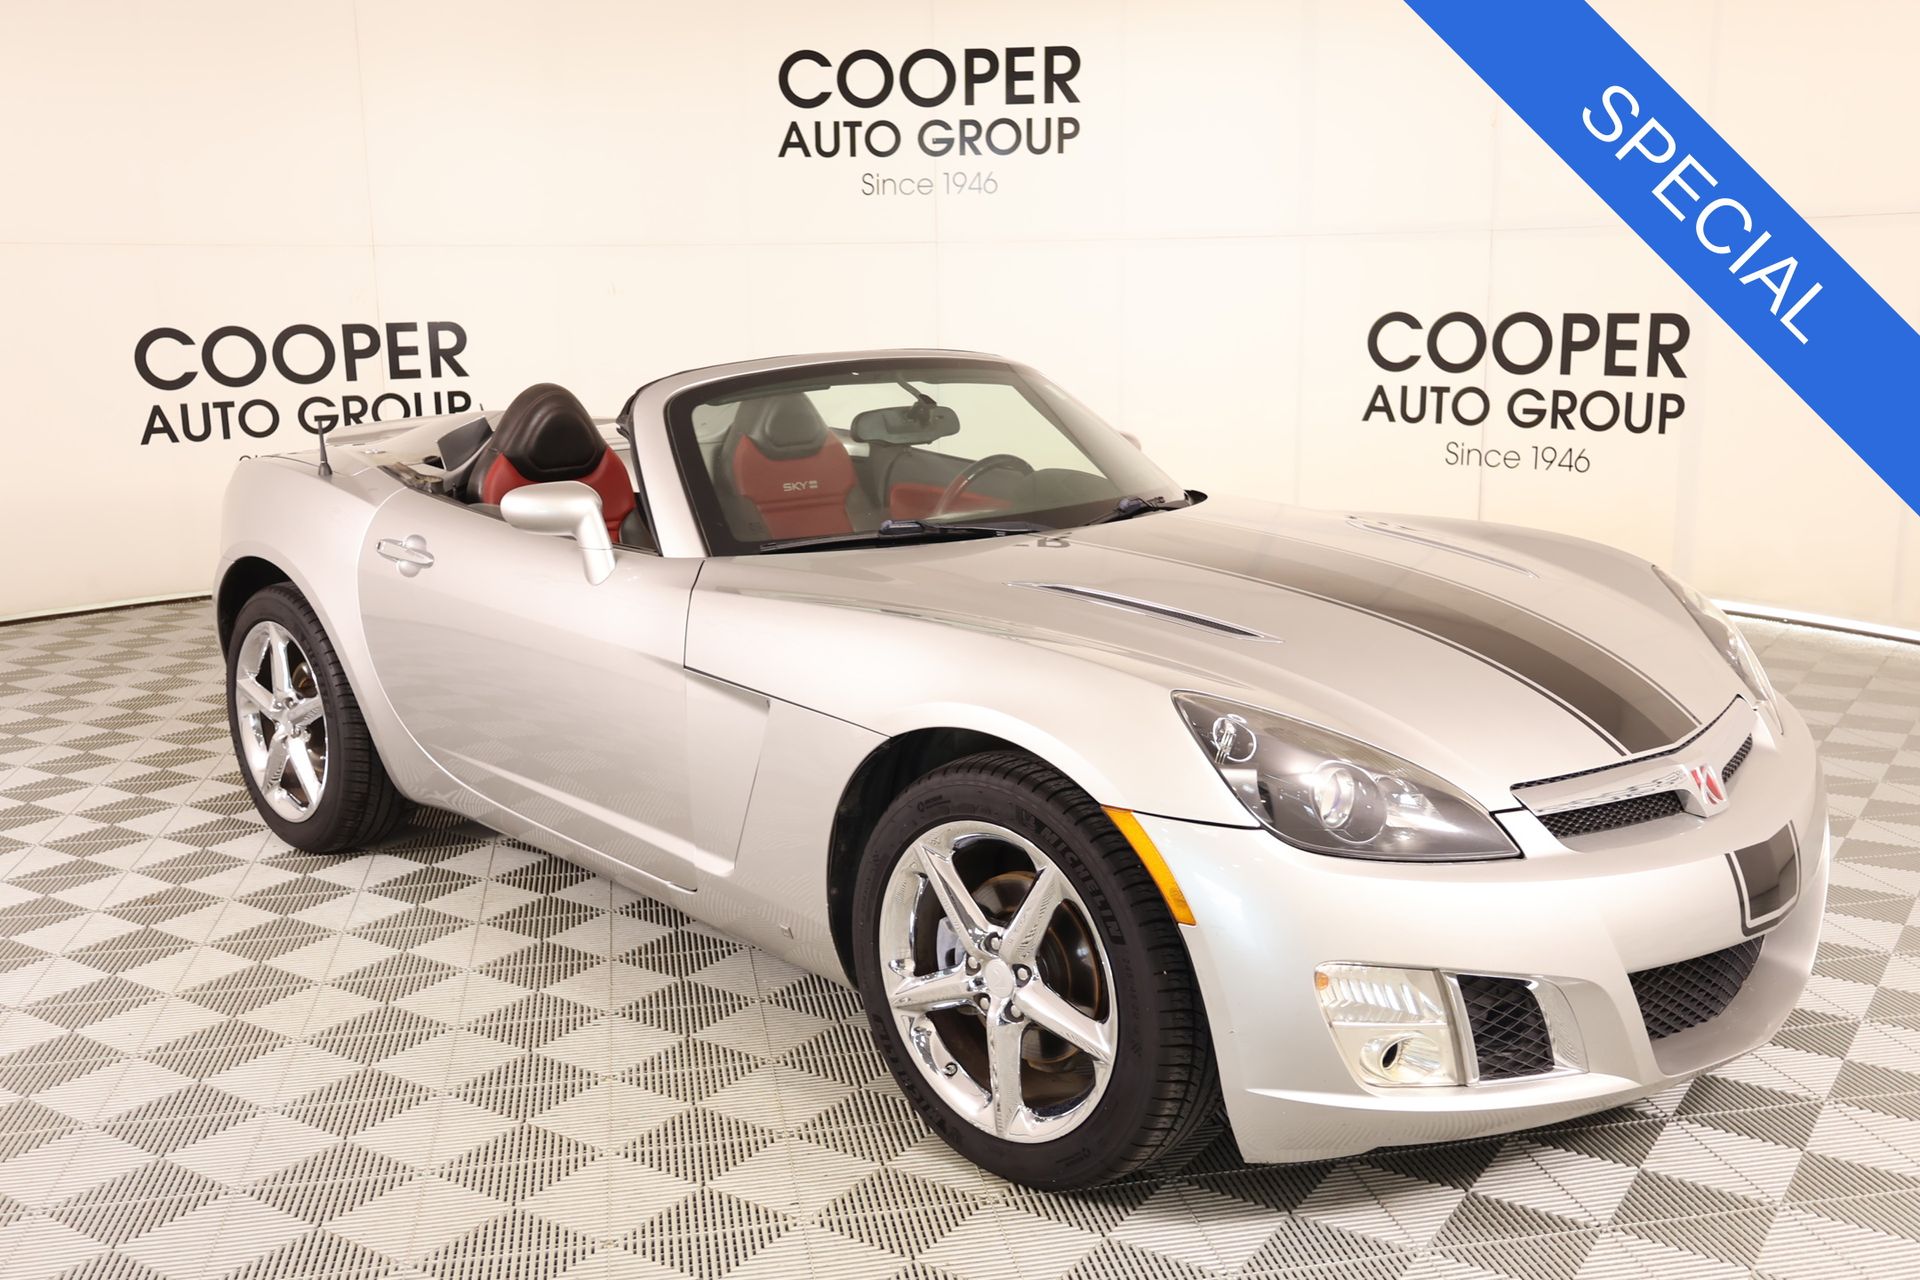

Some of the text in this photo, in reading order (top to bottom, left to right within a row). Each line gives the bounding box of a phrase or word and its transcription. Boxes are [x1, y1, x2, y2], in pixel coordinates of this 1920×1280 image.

[778, 45, 1081, 109] COOPER
[777, 116, 1081, 158] AUTO GROUP
[861, 171, 999, 196] Since 1946
[134, 321, 470, 391] COOPER
[1367, 311, 1691, 379] COOPER
[140, 390, 472, 445] AUTO GROUP
[1361, 384, 1686, 435] AUTO GROUP
[1445, 440, 1591, 473] Since 1946
[783, 481, 808, 491] SKY
[1037, 820, 1124, 942] MICHELIN
